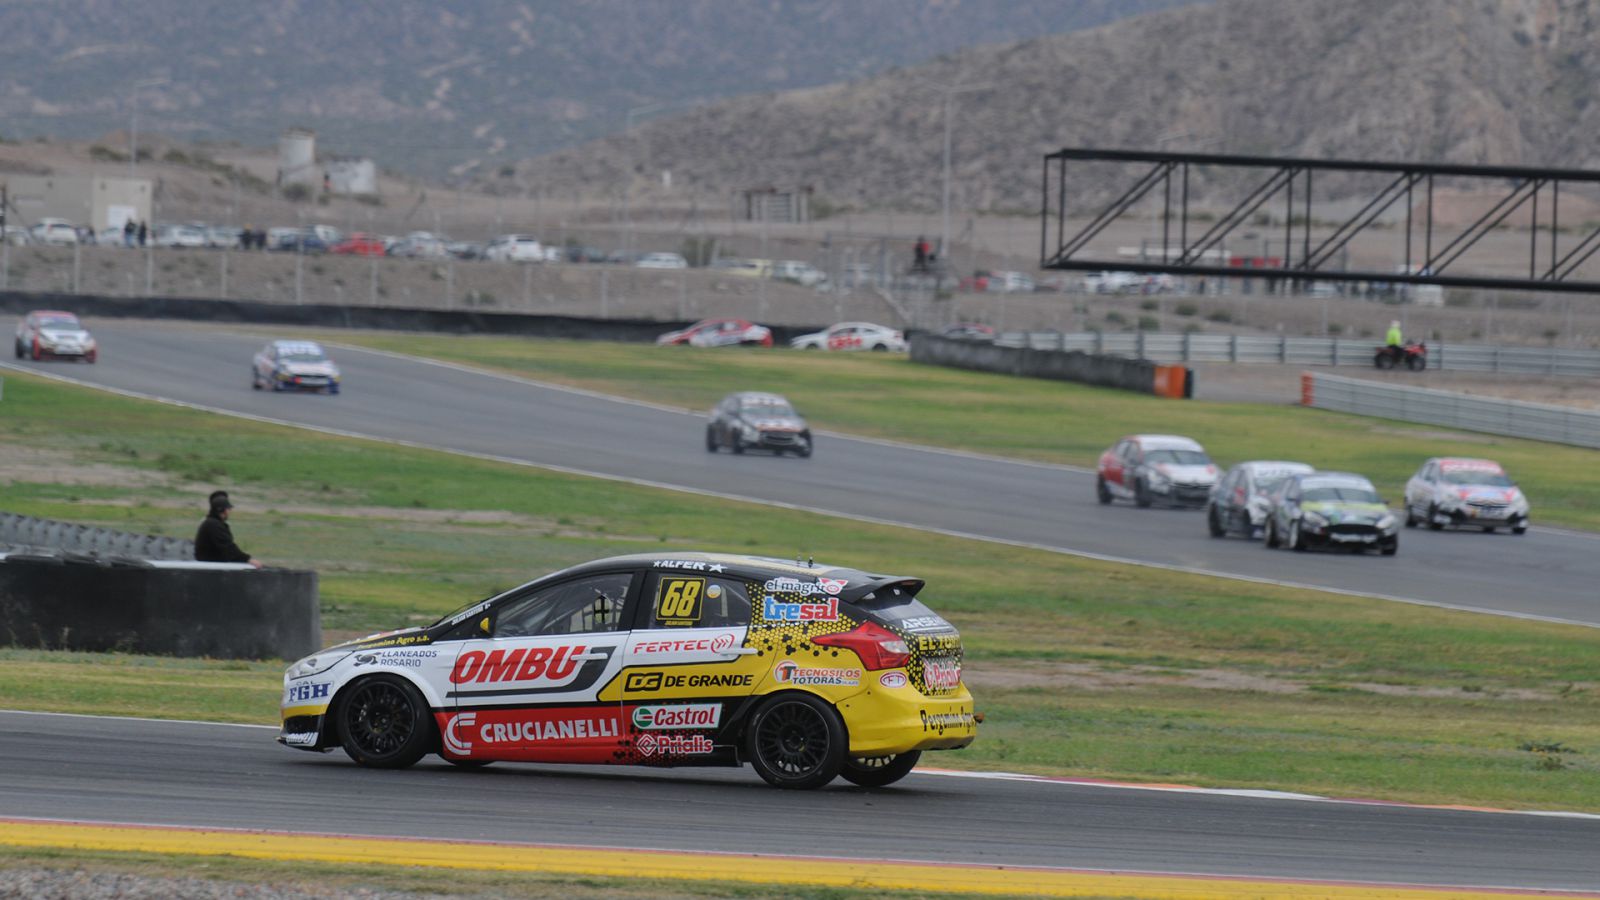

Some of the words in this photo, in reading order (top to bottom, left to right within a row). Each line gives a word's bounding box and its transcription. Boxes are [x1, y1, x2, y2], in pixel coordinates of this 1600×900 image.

[661, 560, 706, 570] ALFER
[766, 580, 778, 590] el
[660, 581, 701, 617] 68
[765, 597, 837, 620] tresal
[633, 639, 709, 654] FERTEC
[918, 636, 936, 651] EL
[382, 651, 437, 659] LLANEADOS
[380, 659, 422, 667] ROSARIO
[664, 675, 686, 687] DE
[688, 674, 754, 687] GRANDE
[793, 669, 860, 678] TECNOSILOS
[793, 677, 842, 685] TOTORAS
[288, 683, 331, 703] FGH
[654, 707, 715, 726] Castrol
[480, 718, 619, 743] CRUCIANELLI
[657, 735, 713, 754] Prialis
